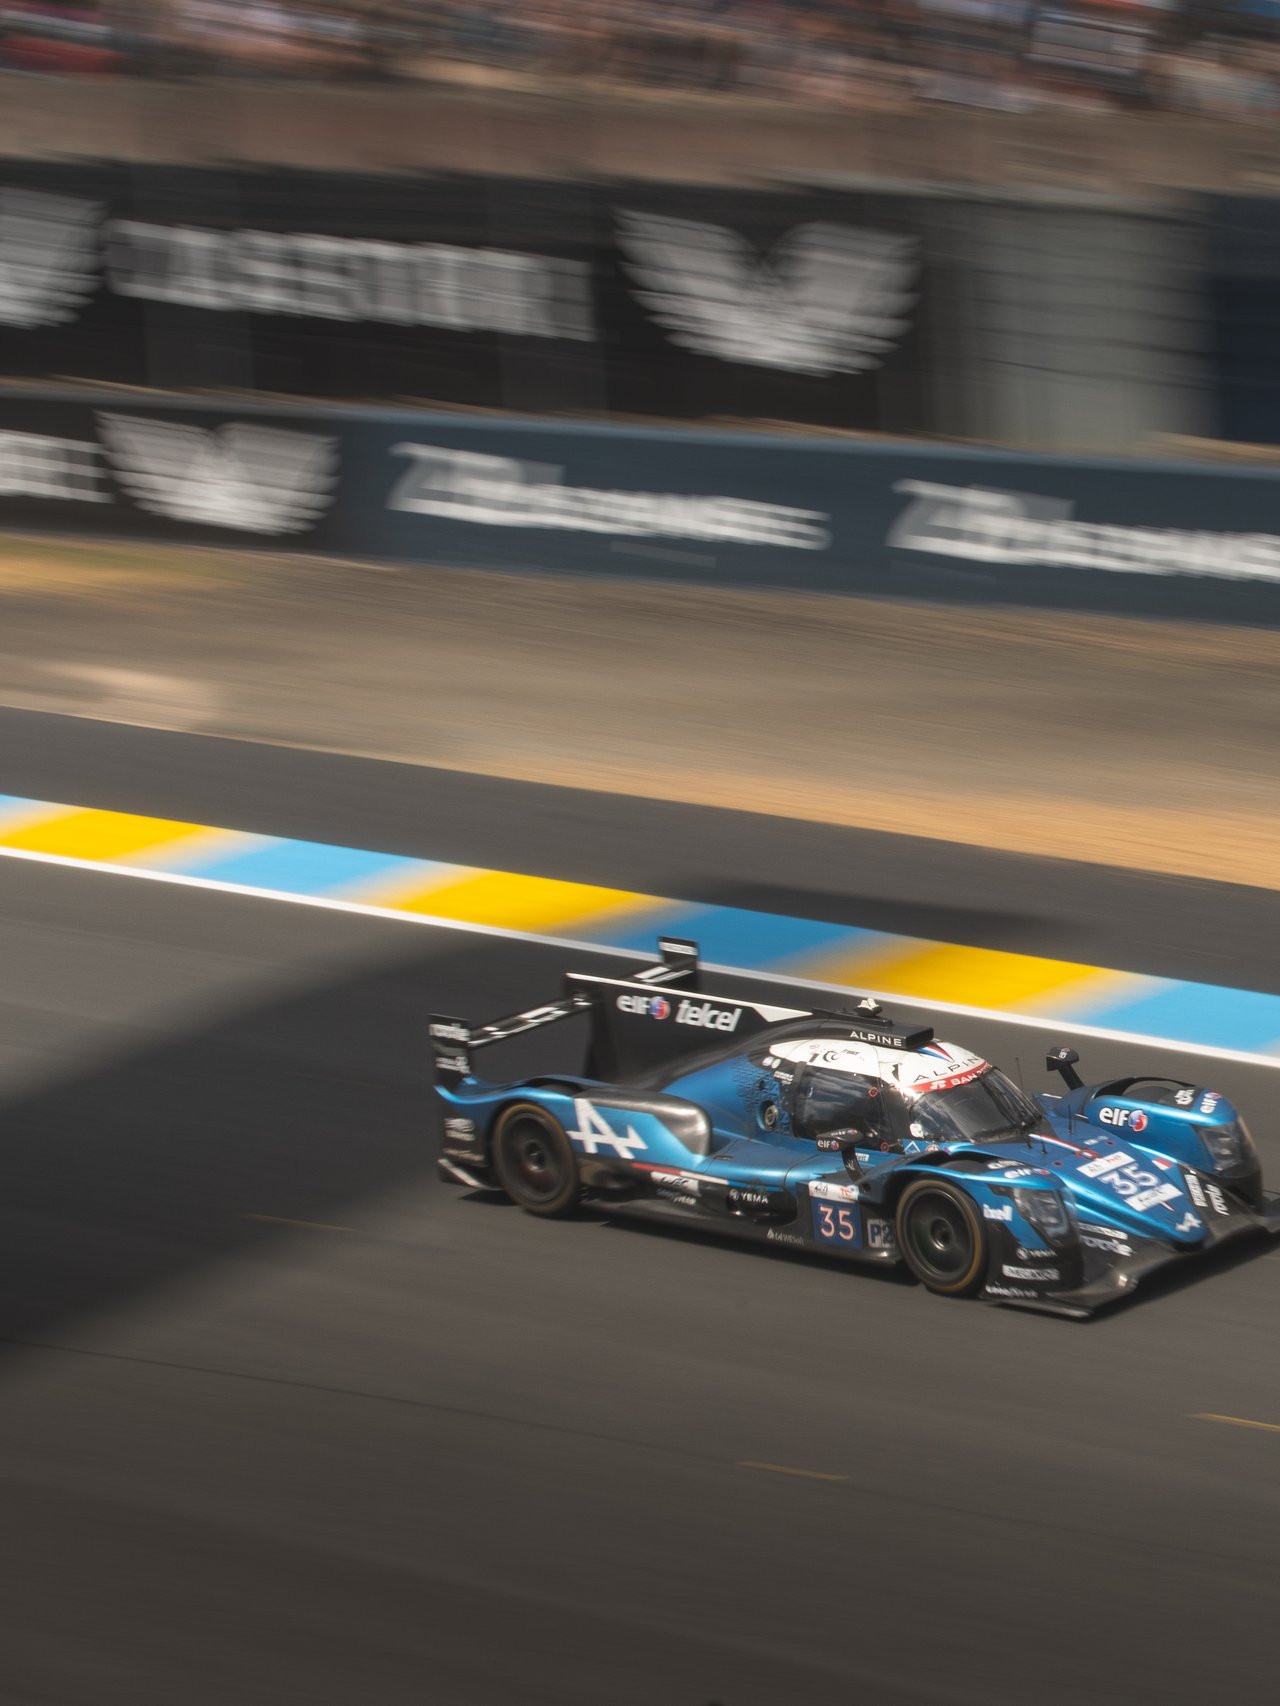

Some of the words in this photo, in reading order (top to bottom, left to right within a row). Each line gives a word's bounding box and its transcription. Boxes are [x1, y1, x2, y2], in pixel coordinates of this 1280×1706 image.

[616, 994, 651, 1015] elf
[675, 999, 743, 1032] telcel
[849, 1030, 903, 1047] ALPINE
[1100, 1107, 1129, 1127] elf
[817, 1139, 831, 1149] elf
[1097, 1163, 1159, 1196] 35
[741, 1192, 769, 1205] YEMA
[819, 1206, 854, 1240] 35
